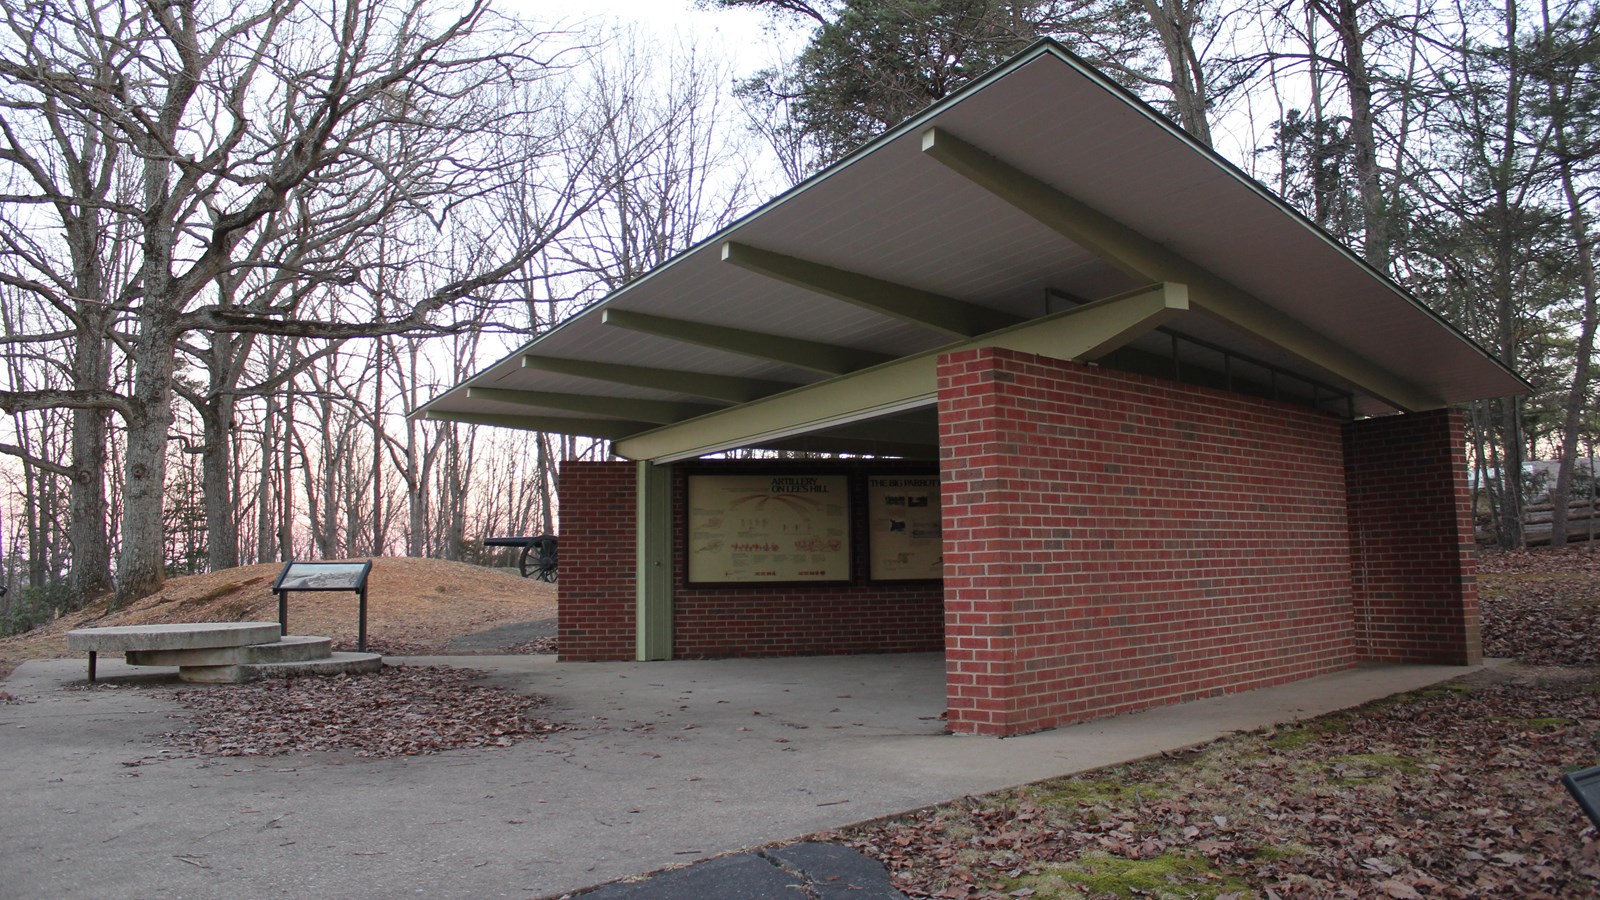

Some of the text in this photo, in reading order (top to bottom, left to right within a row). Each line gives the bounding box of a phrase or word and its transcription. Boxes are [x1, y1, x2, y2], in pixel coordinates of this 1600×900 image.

[771, 477, 818, 485] ARTILLERY
[870, 479, 888, 487] THE
[889, 479, 902, 487] BIG
[771, 485, 785, 493] ON
[810, 485, 829, 493] HILL
